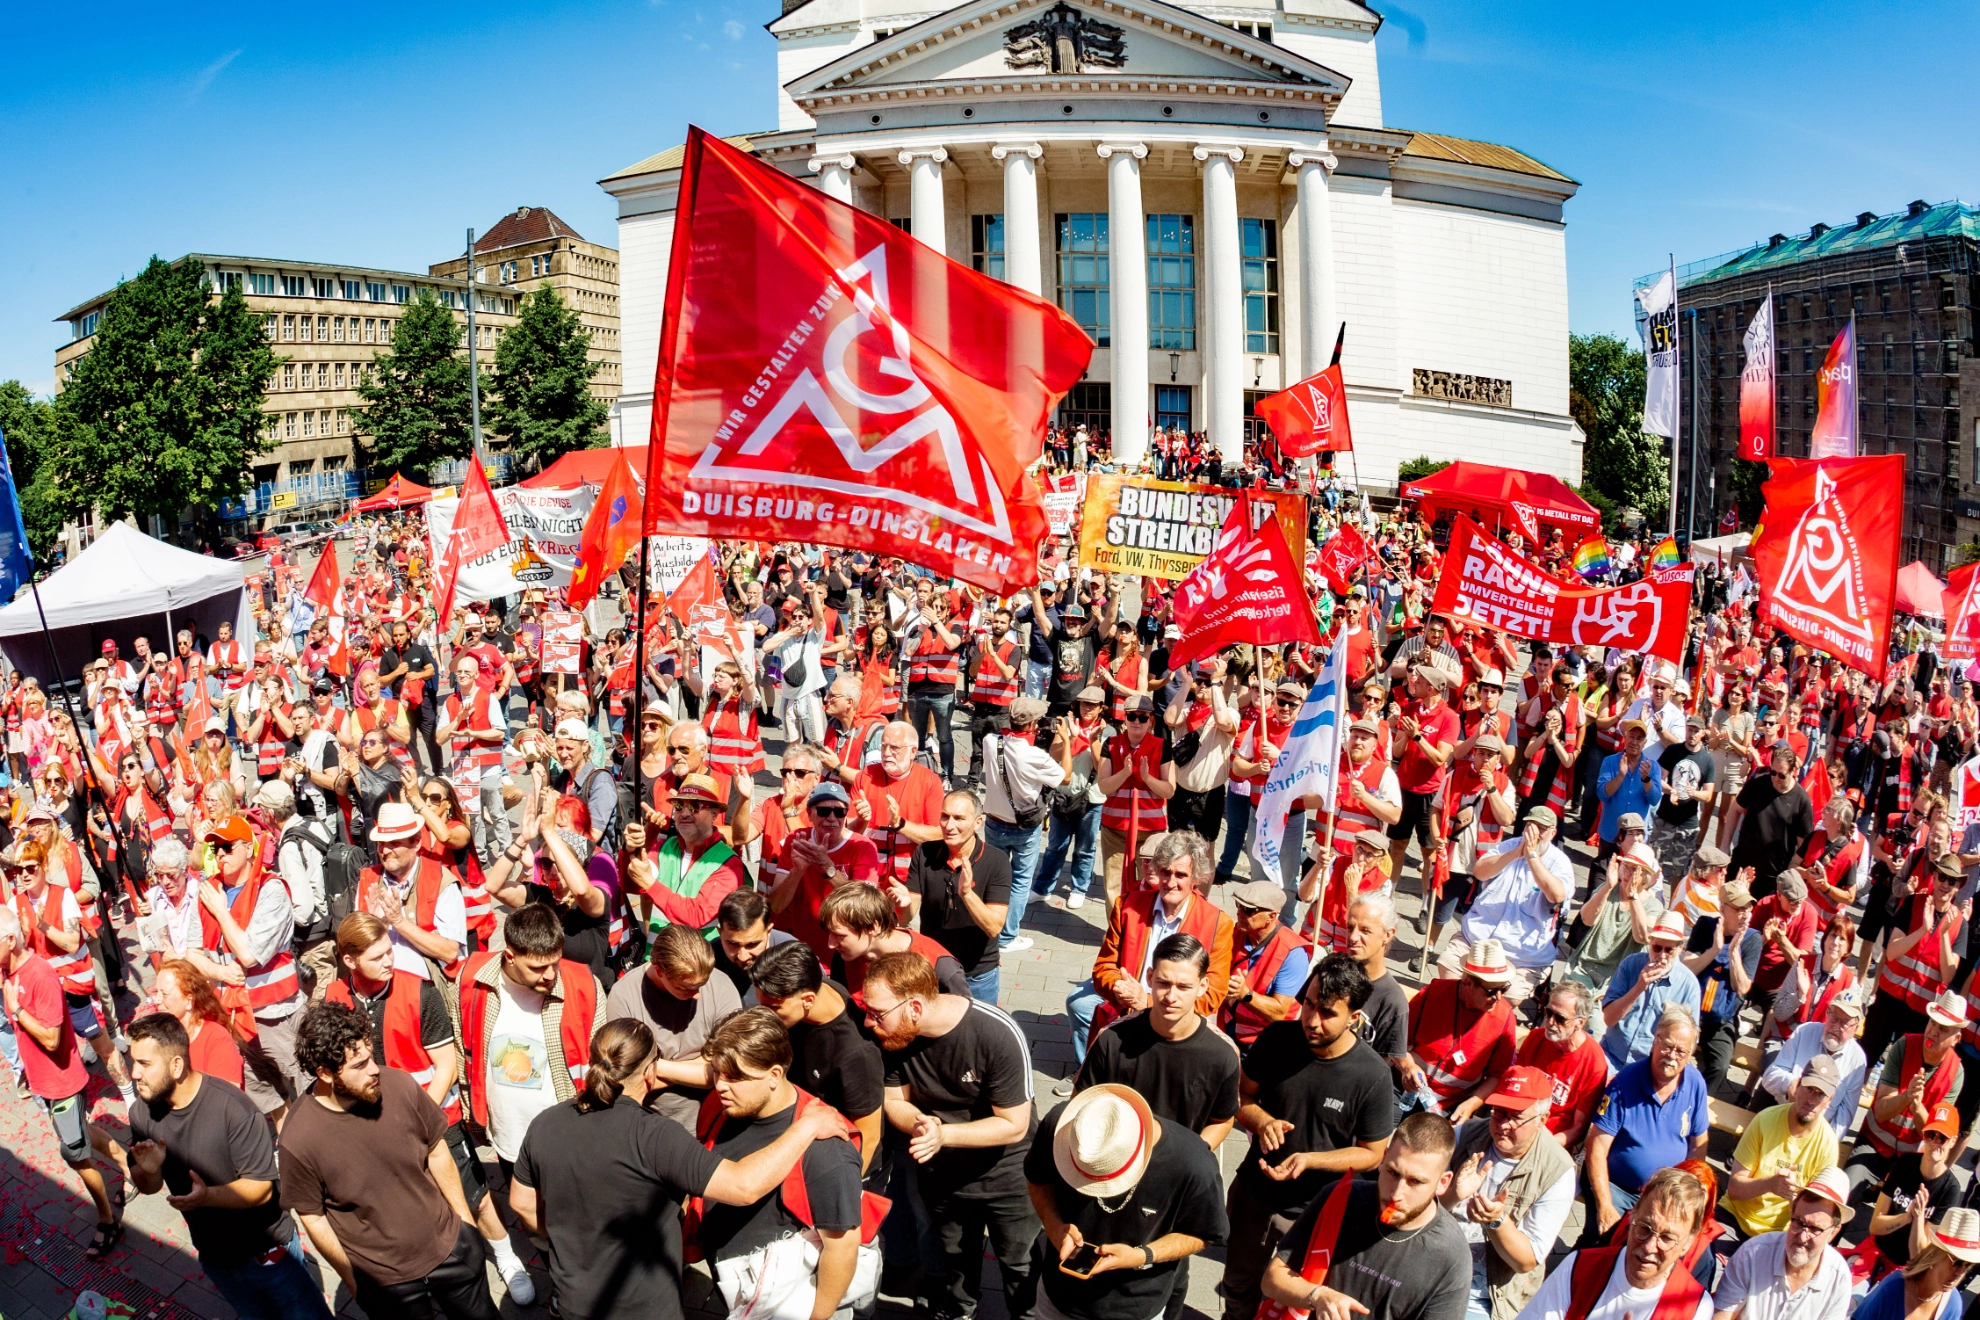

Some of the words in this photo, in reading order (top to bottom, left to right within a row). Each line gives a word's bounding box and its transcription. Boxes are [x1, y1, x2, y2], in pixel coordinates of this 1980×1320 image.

[715, 408, 748, 442] WIR
[742, 319, 815, 408] GESTALTEN
[1753, 436, 1764, 456] Q
[503, 493, 517, 506] IST
[519, 494, 537, 507] DIE
[539, 497, 572, 509] DEVISE
[542, 517, 584, 533] NICHT
[1536, 508, 1546, 516] IG
[1546, 509, 1570, 521] METALL
[1570, 513, 1581, 523] IST
[1582, 514, 1594, 524] DA!
[683, 490, 1012, 575] DUISBURG-DINSLAKEN
[500, 540, 536, 558] EURE
[1095, 547, 1122, 568] Ford,
[1126, 551, 1145, 570] VW,
[655, 567, 688, 583] platz!
[1659, 571, 1687, 583] JUSOS
[1460, 580, 1554, 618] UMVERTEILEN
[1453, 593, 1552, 638] JETZT!
[1597, 1094, 1611, 1116] 3
